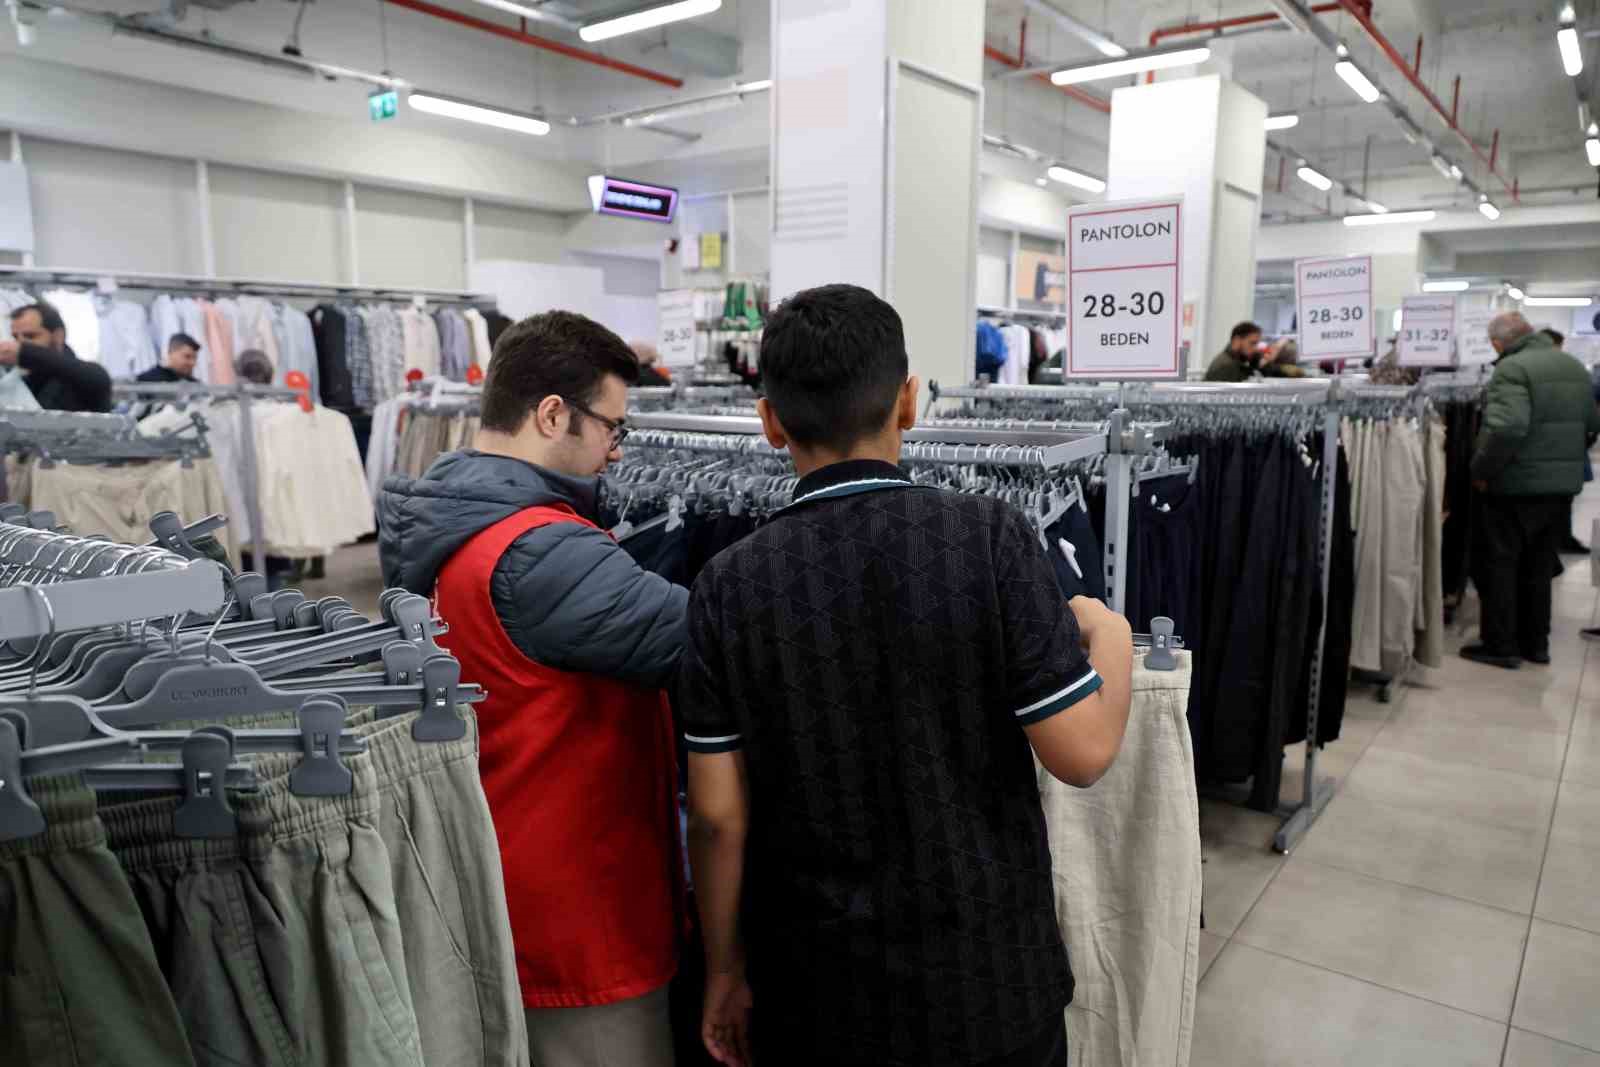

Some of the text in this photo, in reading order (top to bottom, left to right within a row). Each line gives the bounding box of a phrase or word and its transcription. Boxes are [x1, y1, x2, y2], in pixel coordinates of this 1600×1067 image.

[1080, 221, 1171, 242] PANTOLON
[1306, 264, 1367, 280] PANTOLON
[1083, 291, 1165, 318] 28-30
[1308, 306, 1363, 323] 28-30
[1100, 331, 1150, 346] BEDEN
[1321, 330, 1354, 339] BEDEN
